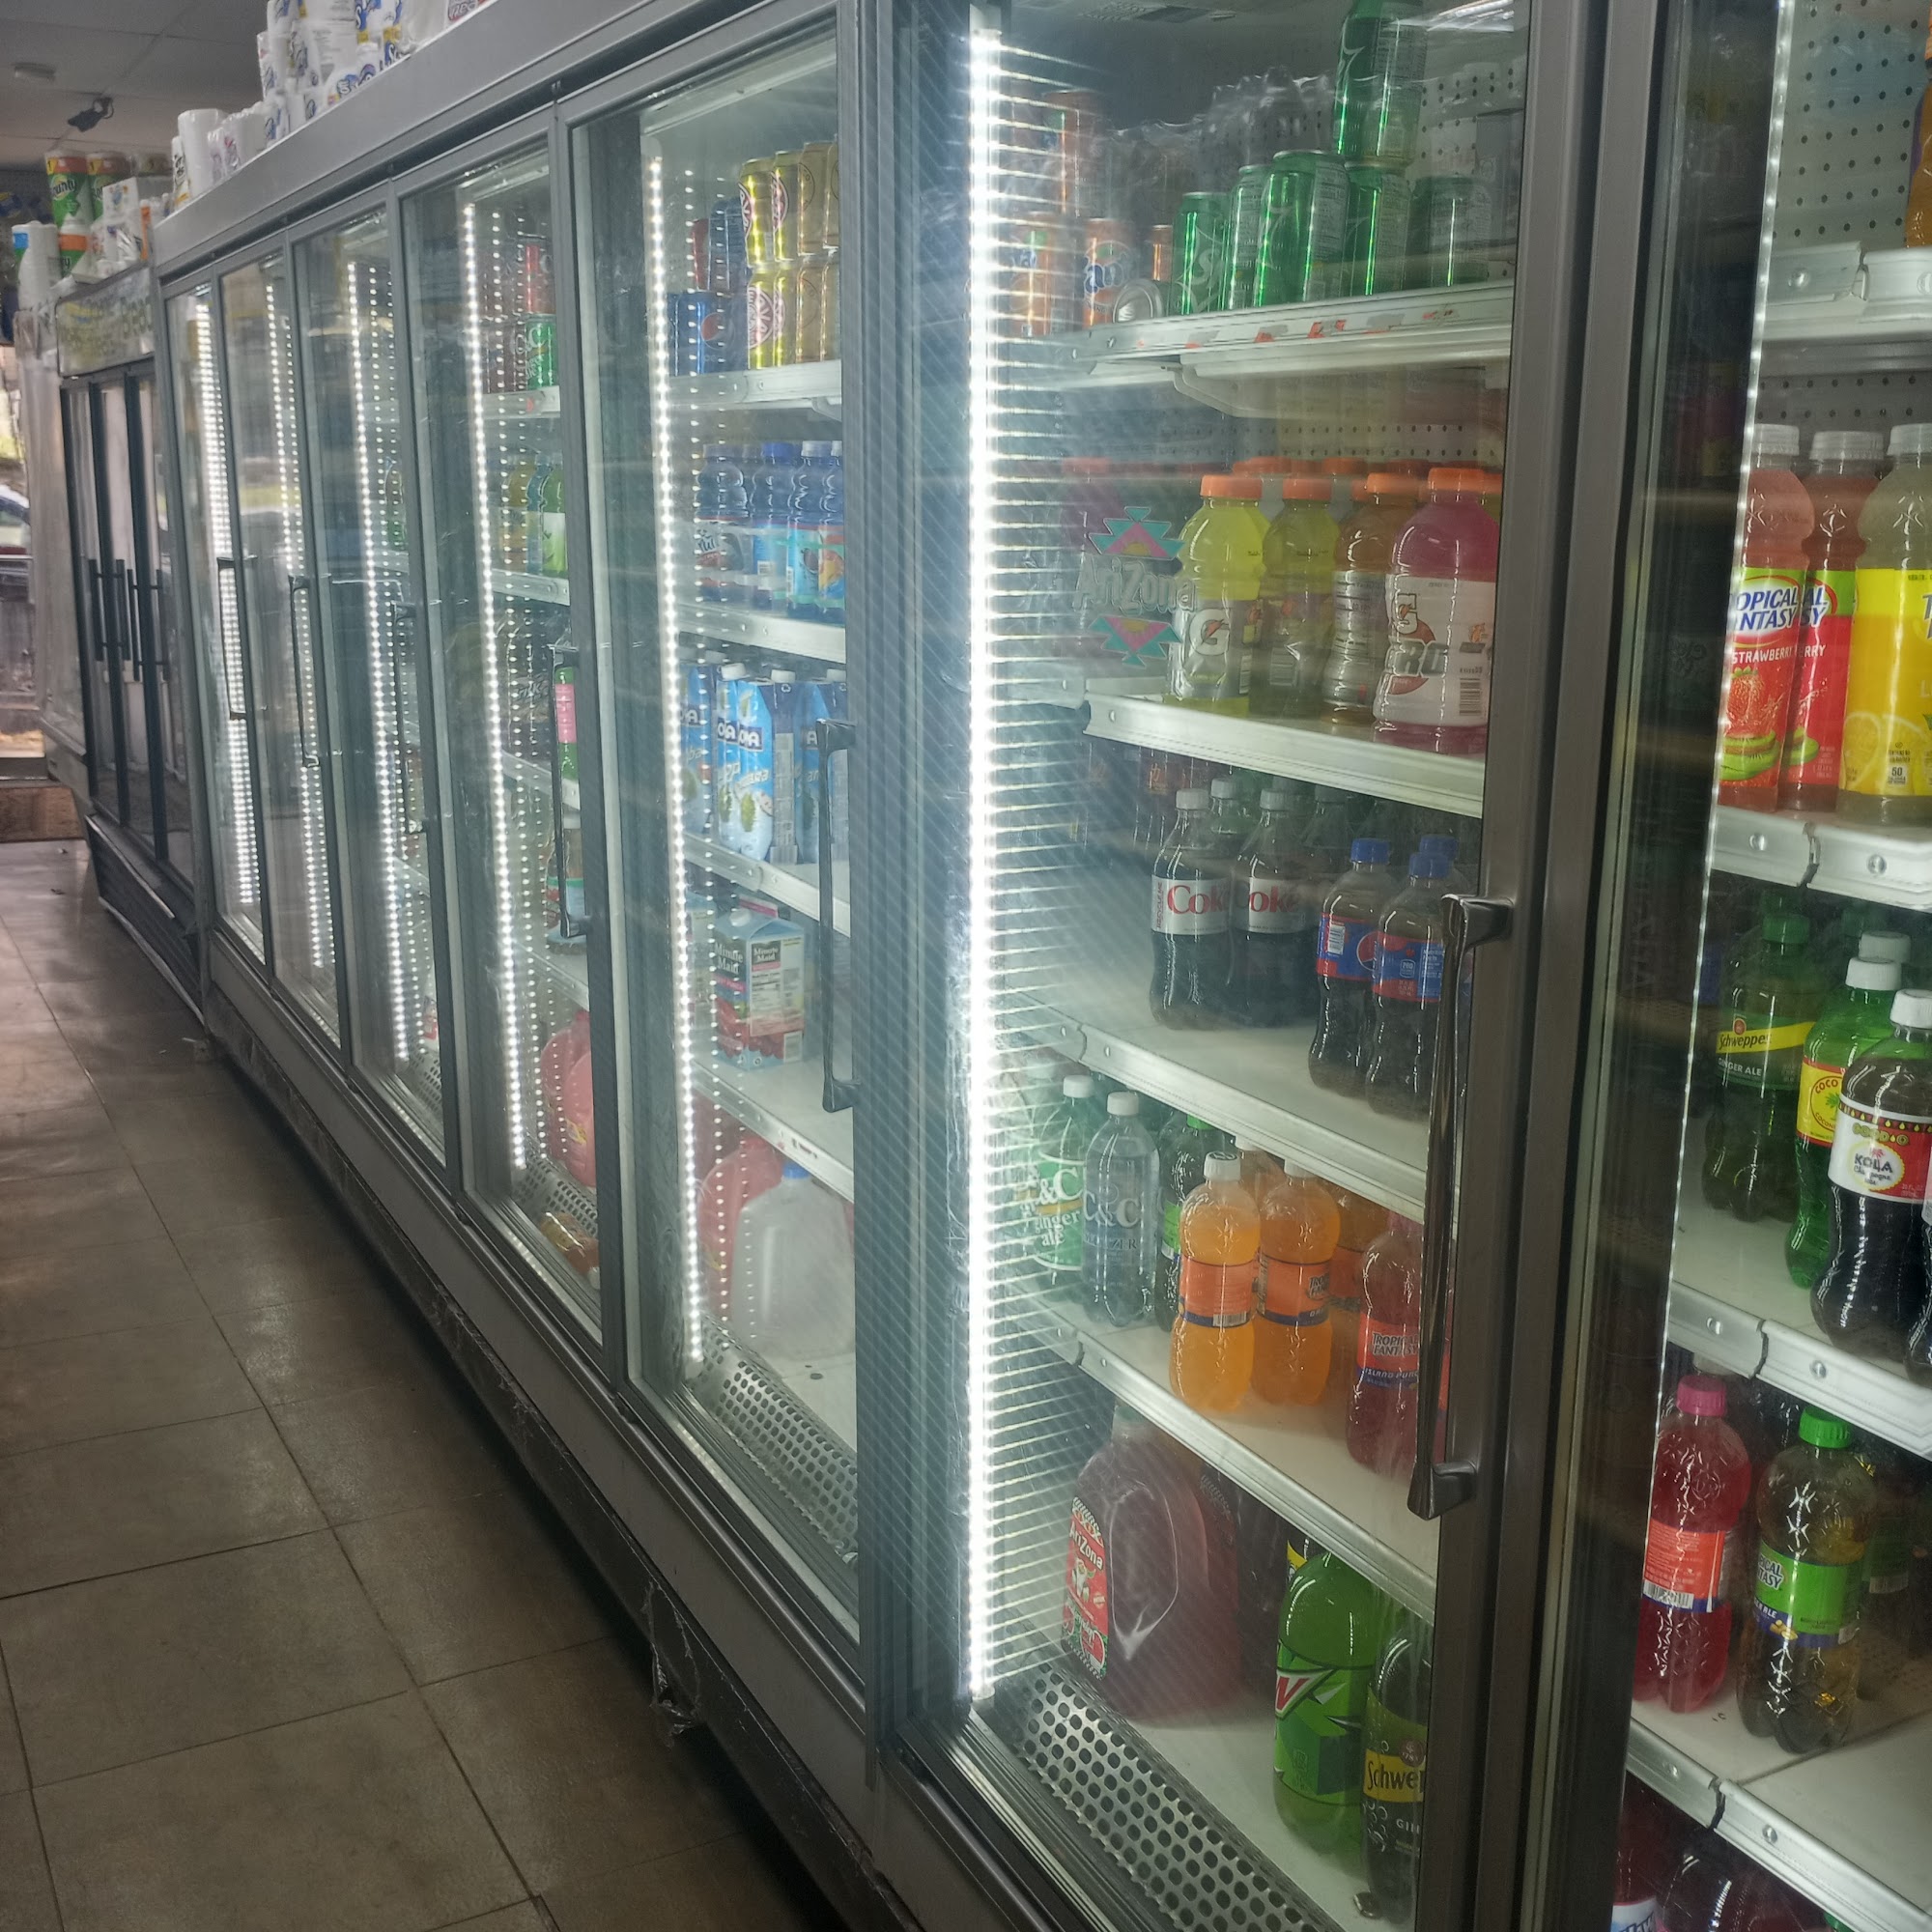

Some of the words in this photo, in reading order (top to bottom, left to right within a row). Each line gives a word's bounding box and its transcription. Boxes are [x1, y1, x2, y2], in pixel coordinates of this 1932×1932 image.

[1719, 1034, 1773, 1050] Schweppes
[1745, 1067, 1763, 1077] ALE
[1040, 1230, 1065, 1247] ale
[1068, 1520, 1103, 1571] AriZona
